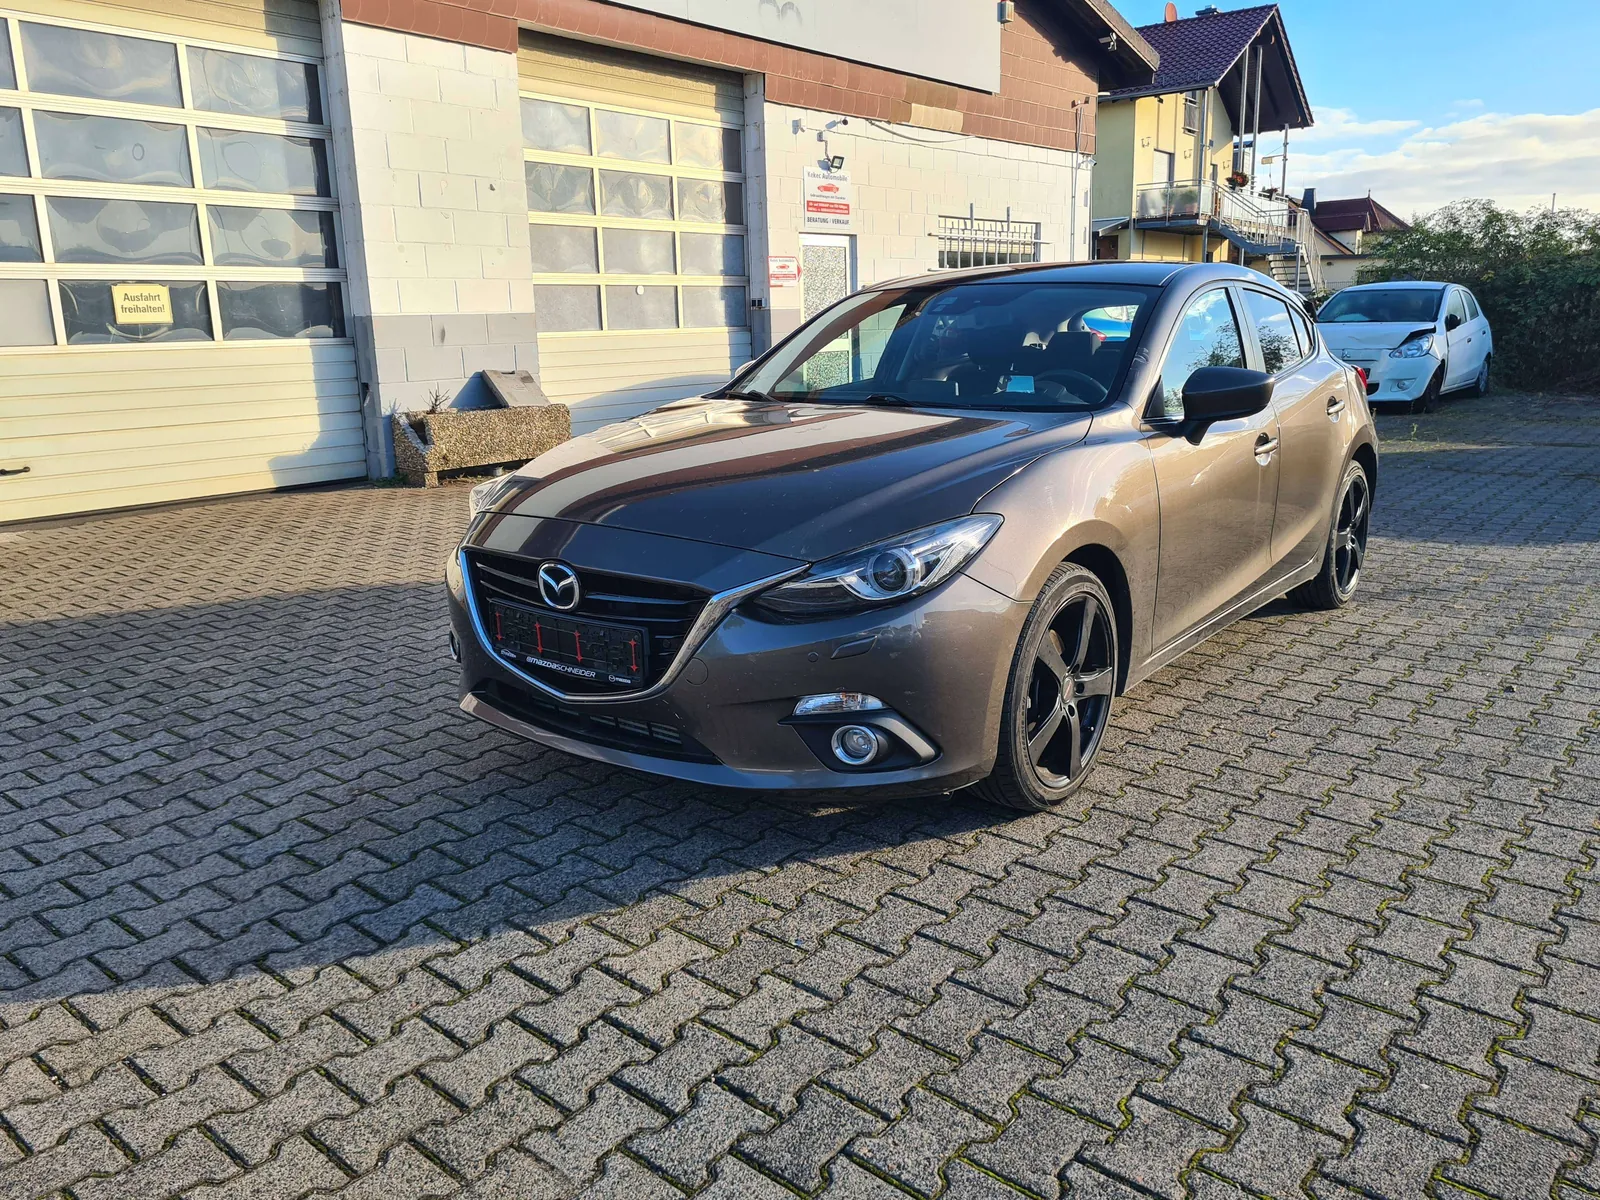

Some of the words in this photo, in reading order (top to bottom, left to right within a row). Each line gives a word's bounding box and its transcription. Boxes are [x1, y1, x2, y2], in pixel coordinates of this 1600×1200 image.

[807, 216, 828, 224] BERATUNG
[123, 293, 161, 302] Ausfahrt
[121, 304, 165, 313] freihalten!
